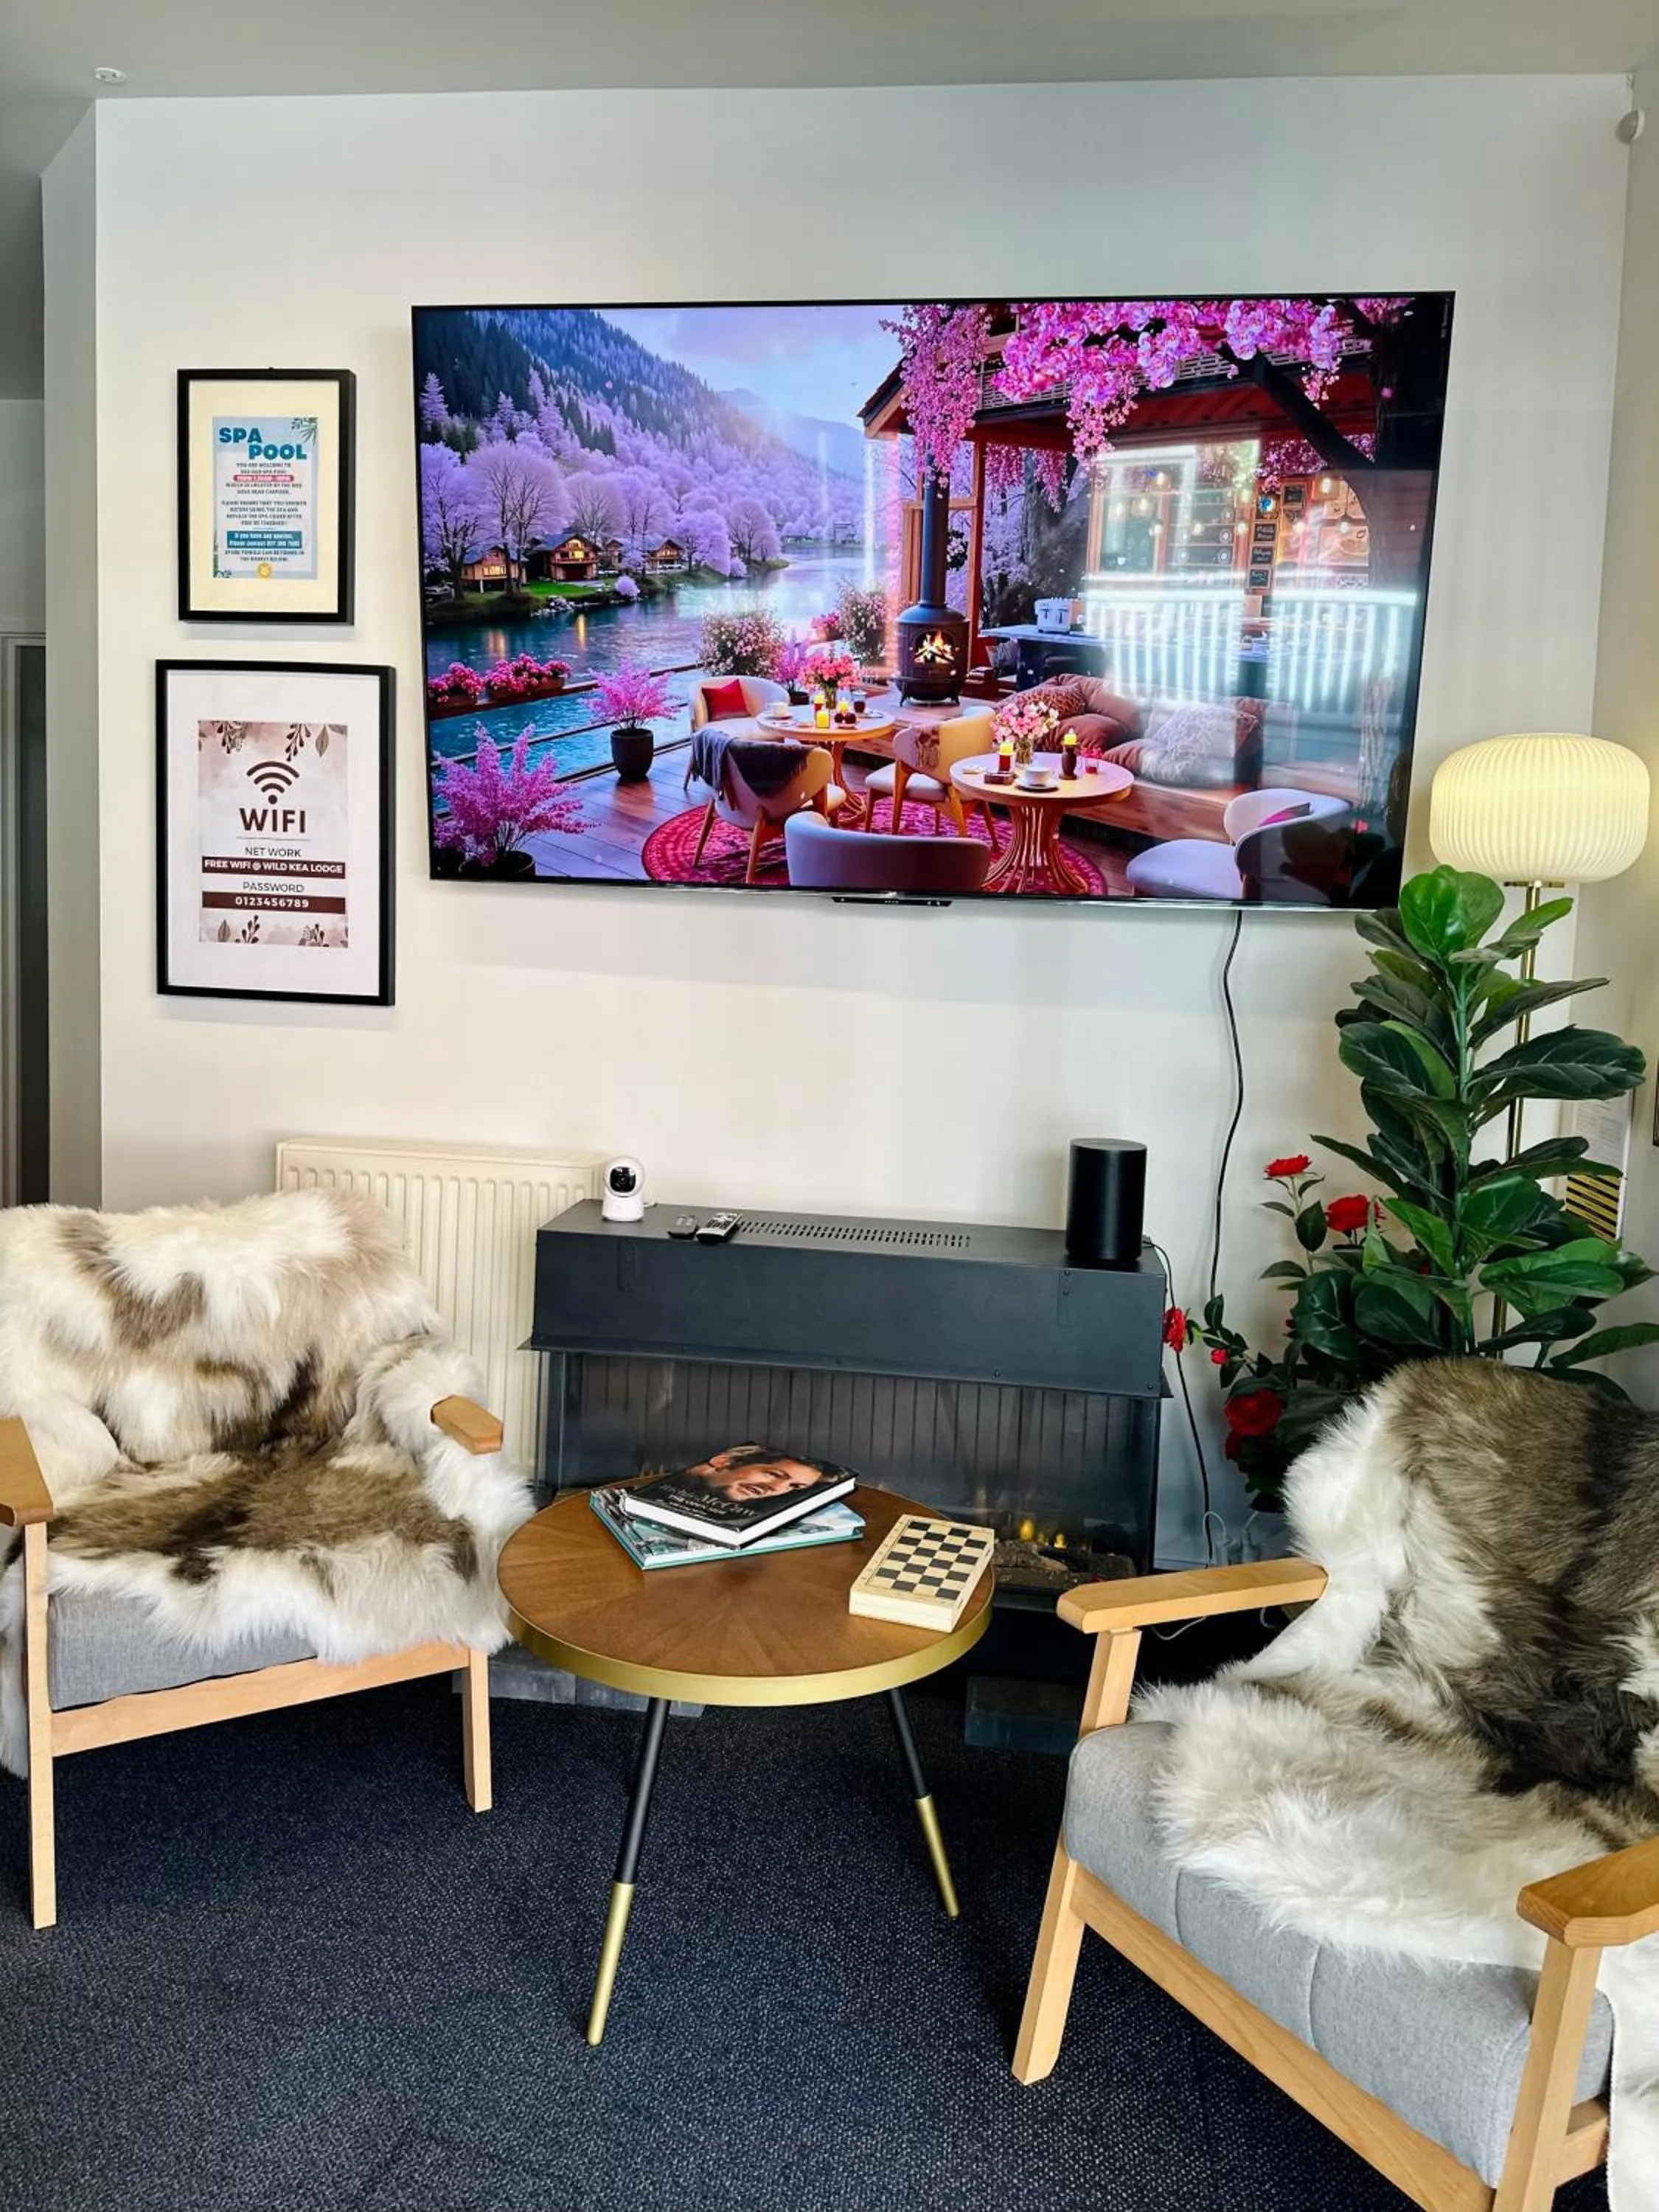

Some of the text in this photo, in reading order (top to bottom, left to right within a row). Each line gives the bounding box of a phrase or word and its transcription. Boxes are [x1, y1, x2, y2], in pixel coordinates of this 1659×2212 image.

[219, 427, 262, 443] SPA
[248, 444, 307, 460] POOL
[240, 807, 306, 833] WIFI
[245, 847, 302, 858] NET WORK
[204, 860, 343, 873] FREE WIFI @ WILD KEA LODGE
[243, 881, 305, 893] PASSWORD
[235, 897, 309, 908] 0123456789
